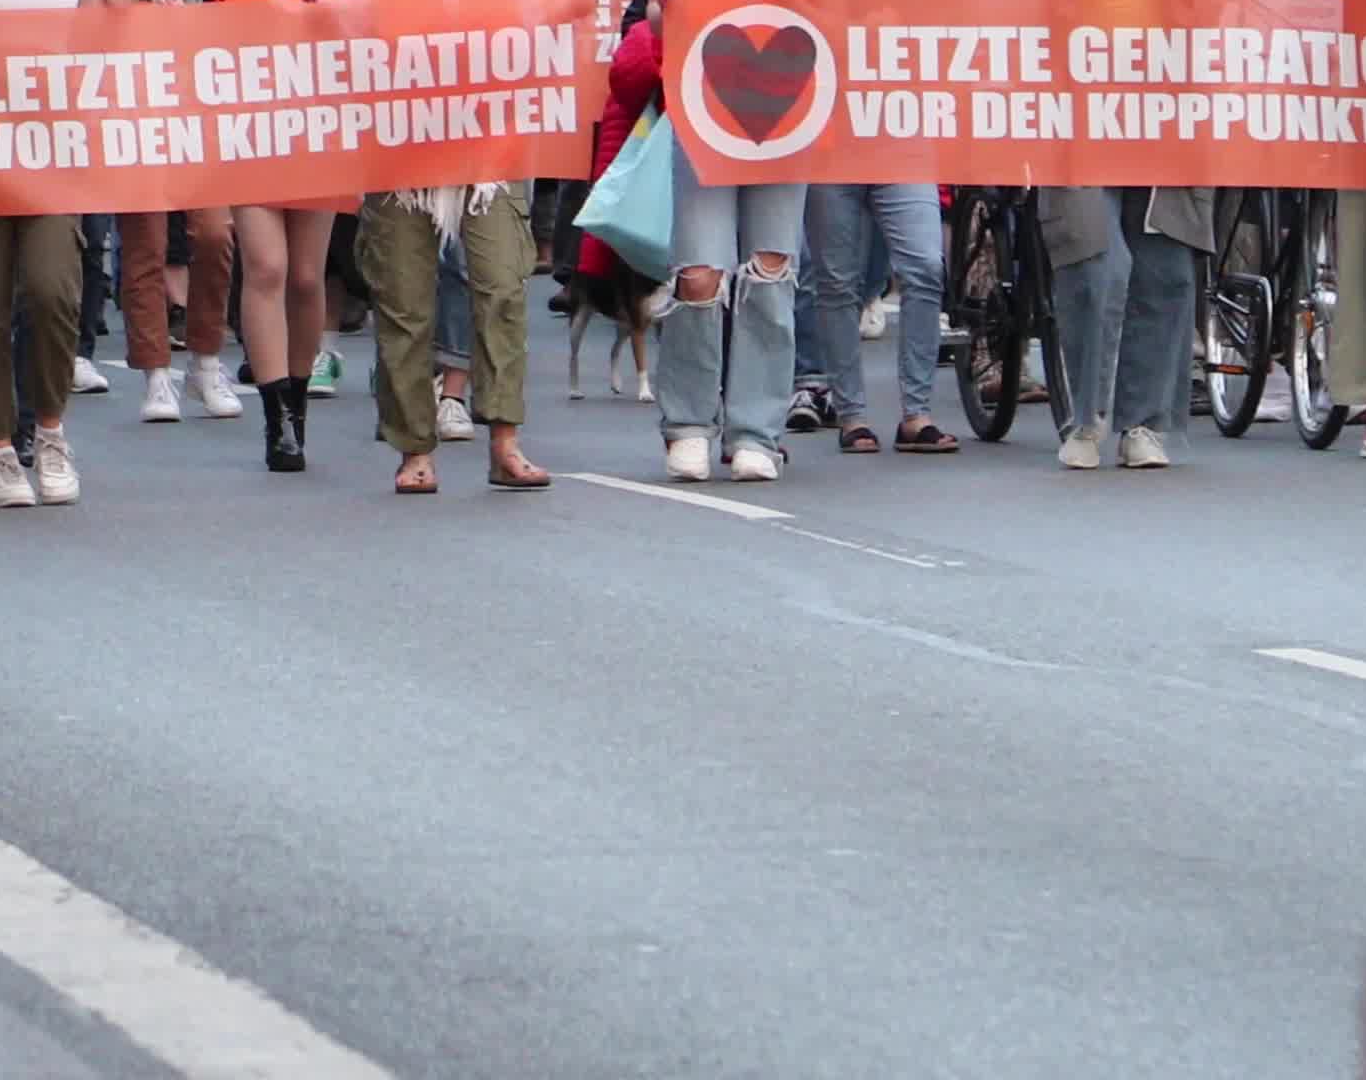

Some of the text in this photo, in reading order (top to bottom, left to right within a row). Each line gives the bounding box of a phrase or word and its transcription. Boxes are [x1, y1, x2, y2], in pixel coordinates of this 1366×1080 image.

[192, 22, 576, 108] GENERATION
[846, 24, 1052, 84] LETZTE
[101, 114, 206, 168] DEN
[216, 85, 578, 163] KIPPPUNKTEN
[849, 90, 958, 139] VOR
[972, 91, 1074, 139] DEN
